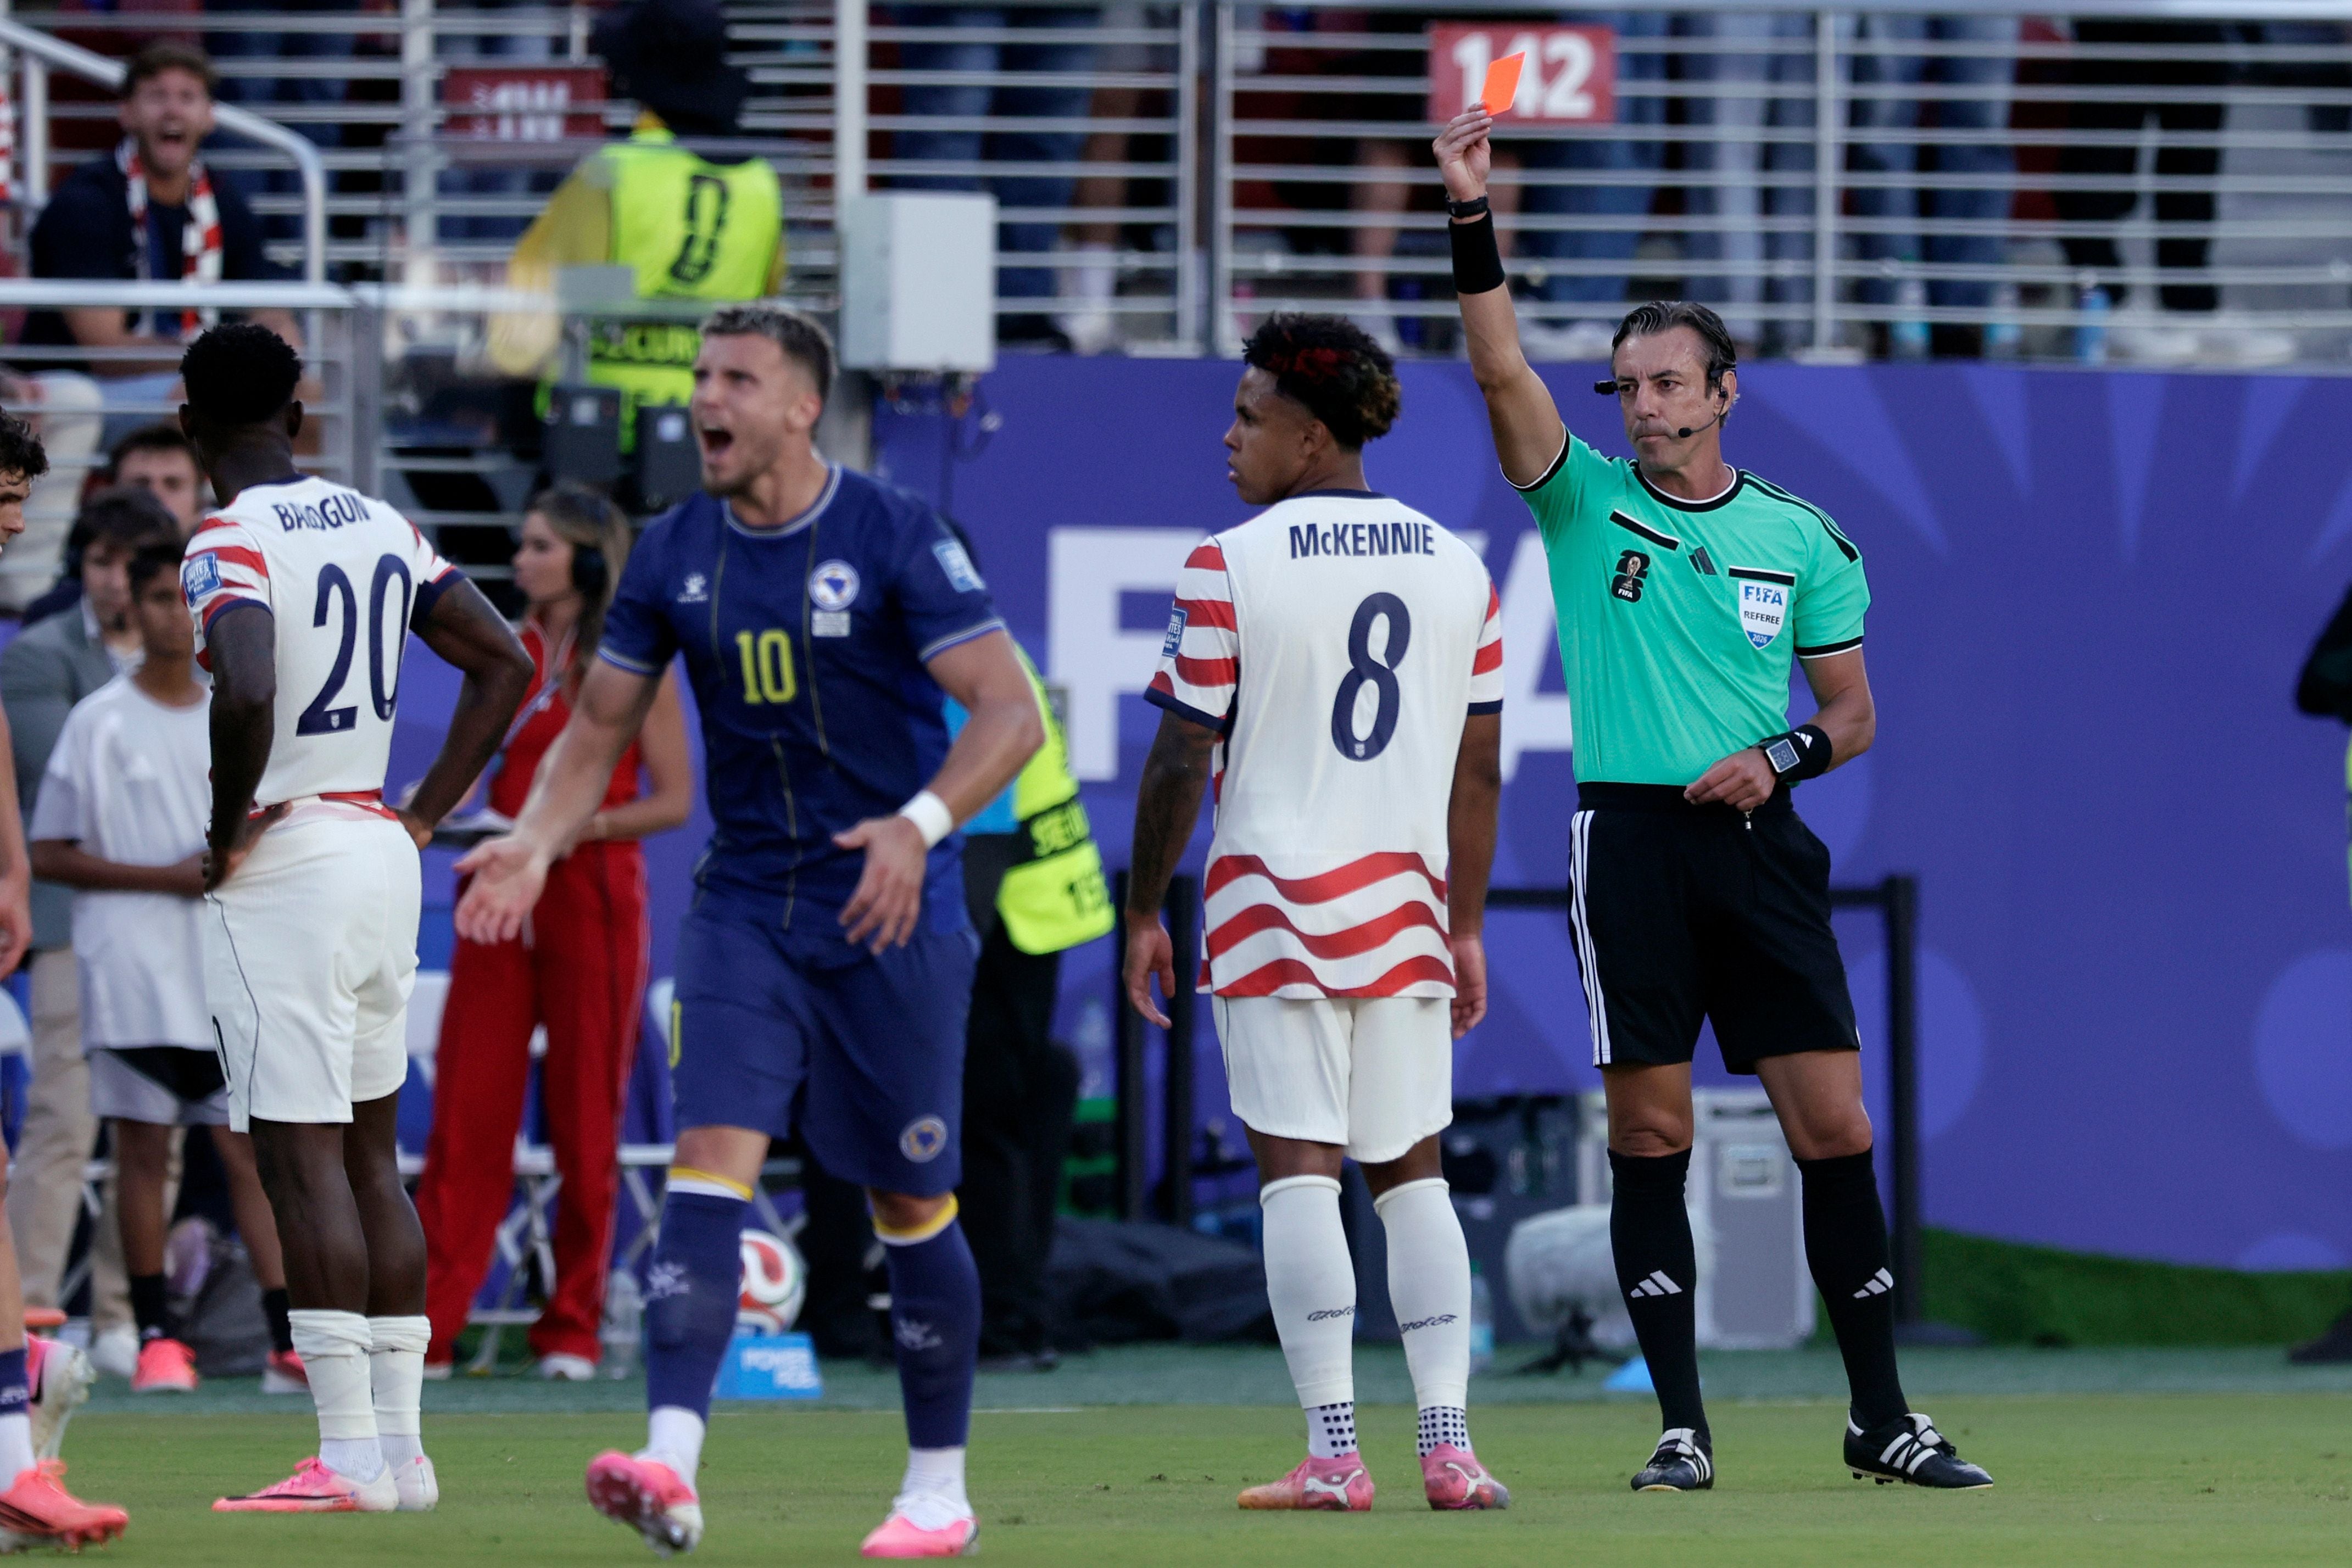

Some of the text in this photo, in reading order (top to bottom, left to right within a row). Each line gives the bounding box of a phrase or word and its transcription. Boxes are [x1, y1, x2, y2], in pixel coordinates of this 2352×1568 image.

[1289, 522, 1435, 560] McKENNIE
[1618, 588, 1633, 599] FIFA
[1744, 585, 1783, 606] FIFA
[1743, 610, 1781, 625] REFEREE
[296, 552, 413, 737] 20
[1752, 633, 1768, 644] 2026
[735, 628, 798, 705] 10
[1331, 592, 1411, 762] 8
